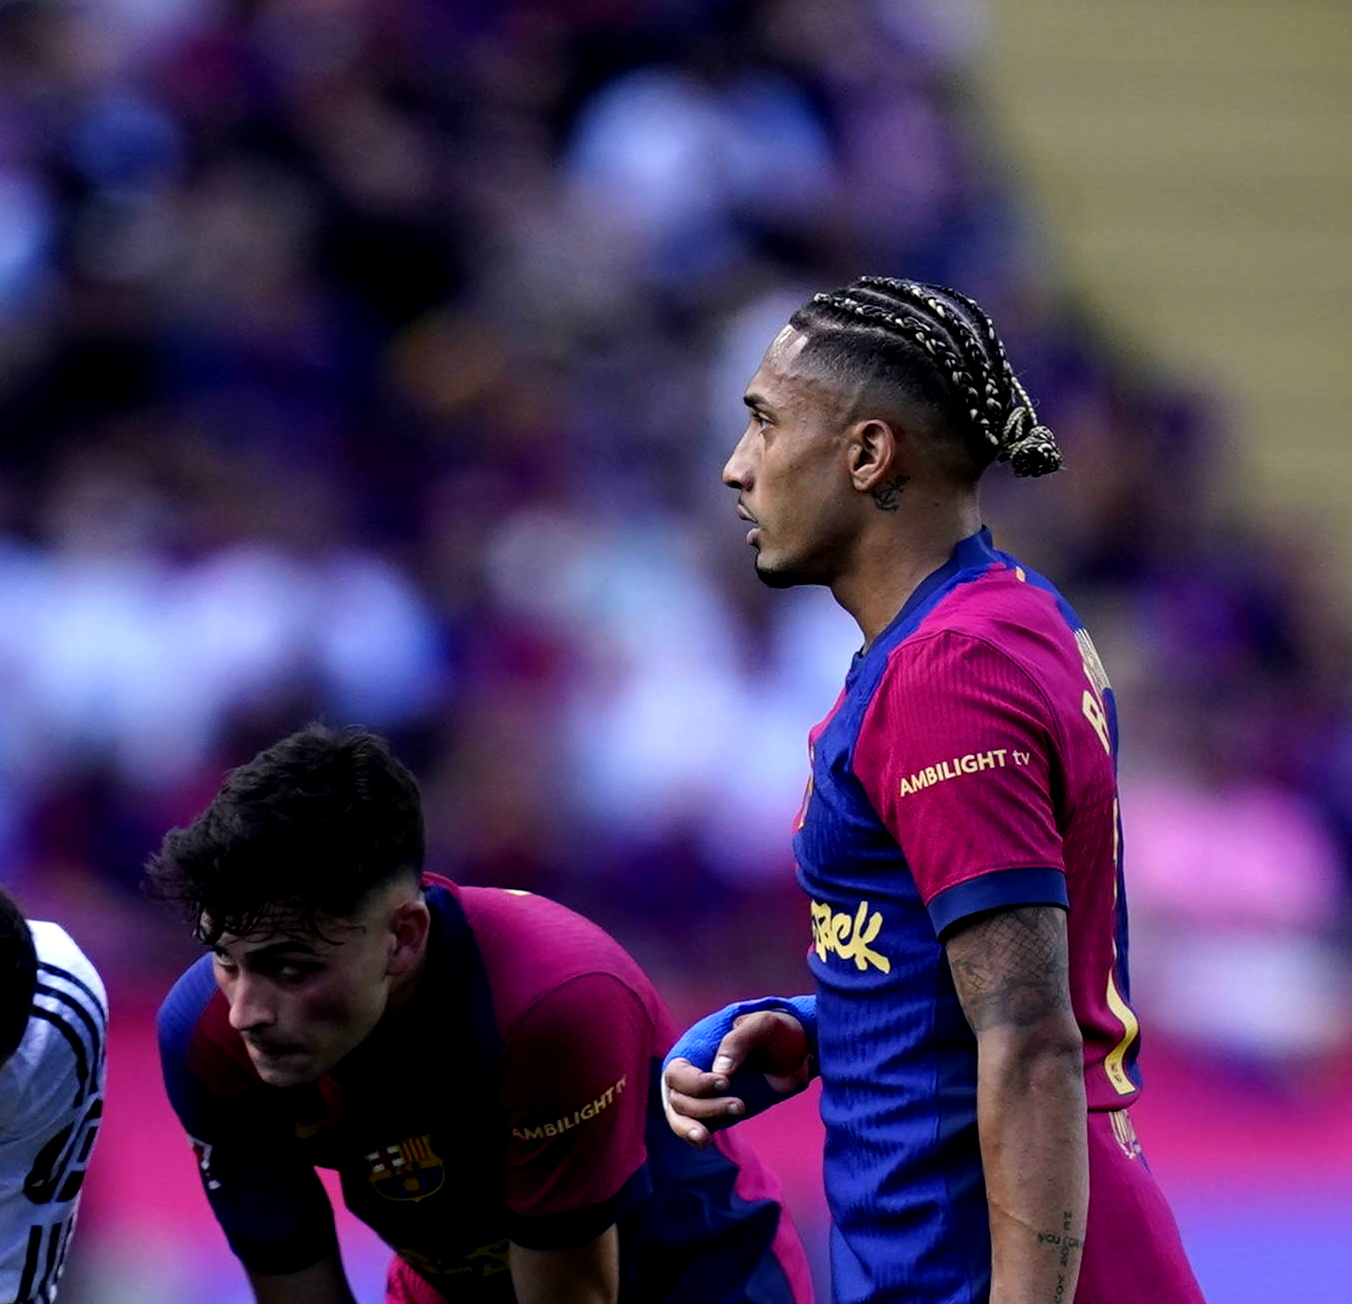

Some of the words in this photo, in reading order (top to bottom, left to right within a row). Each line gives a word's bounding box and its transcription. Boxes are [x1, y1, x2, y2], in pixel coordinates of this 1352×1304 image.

[900, 749, 997, 797] AMBILIGHT
[1012, 750, 1030, 766] tv
[512, 1086, 615, 1140] AMBILIGHT
